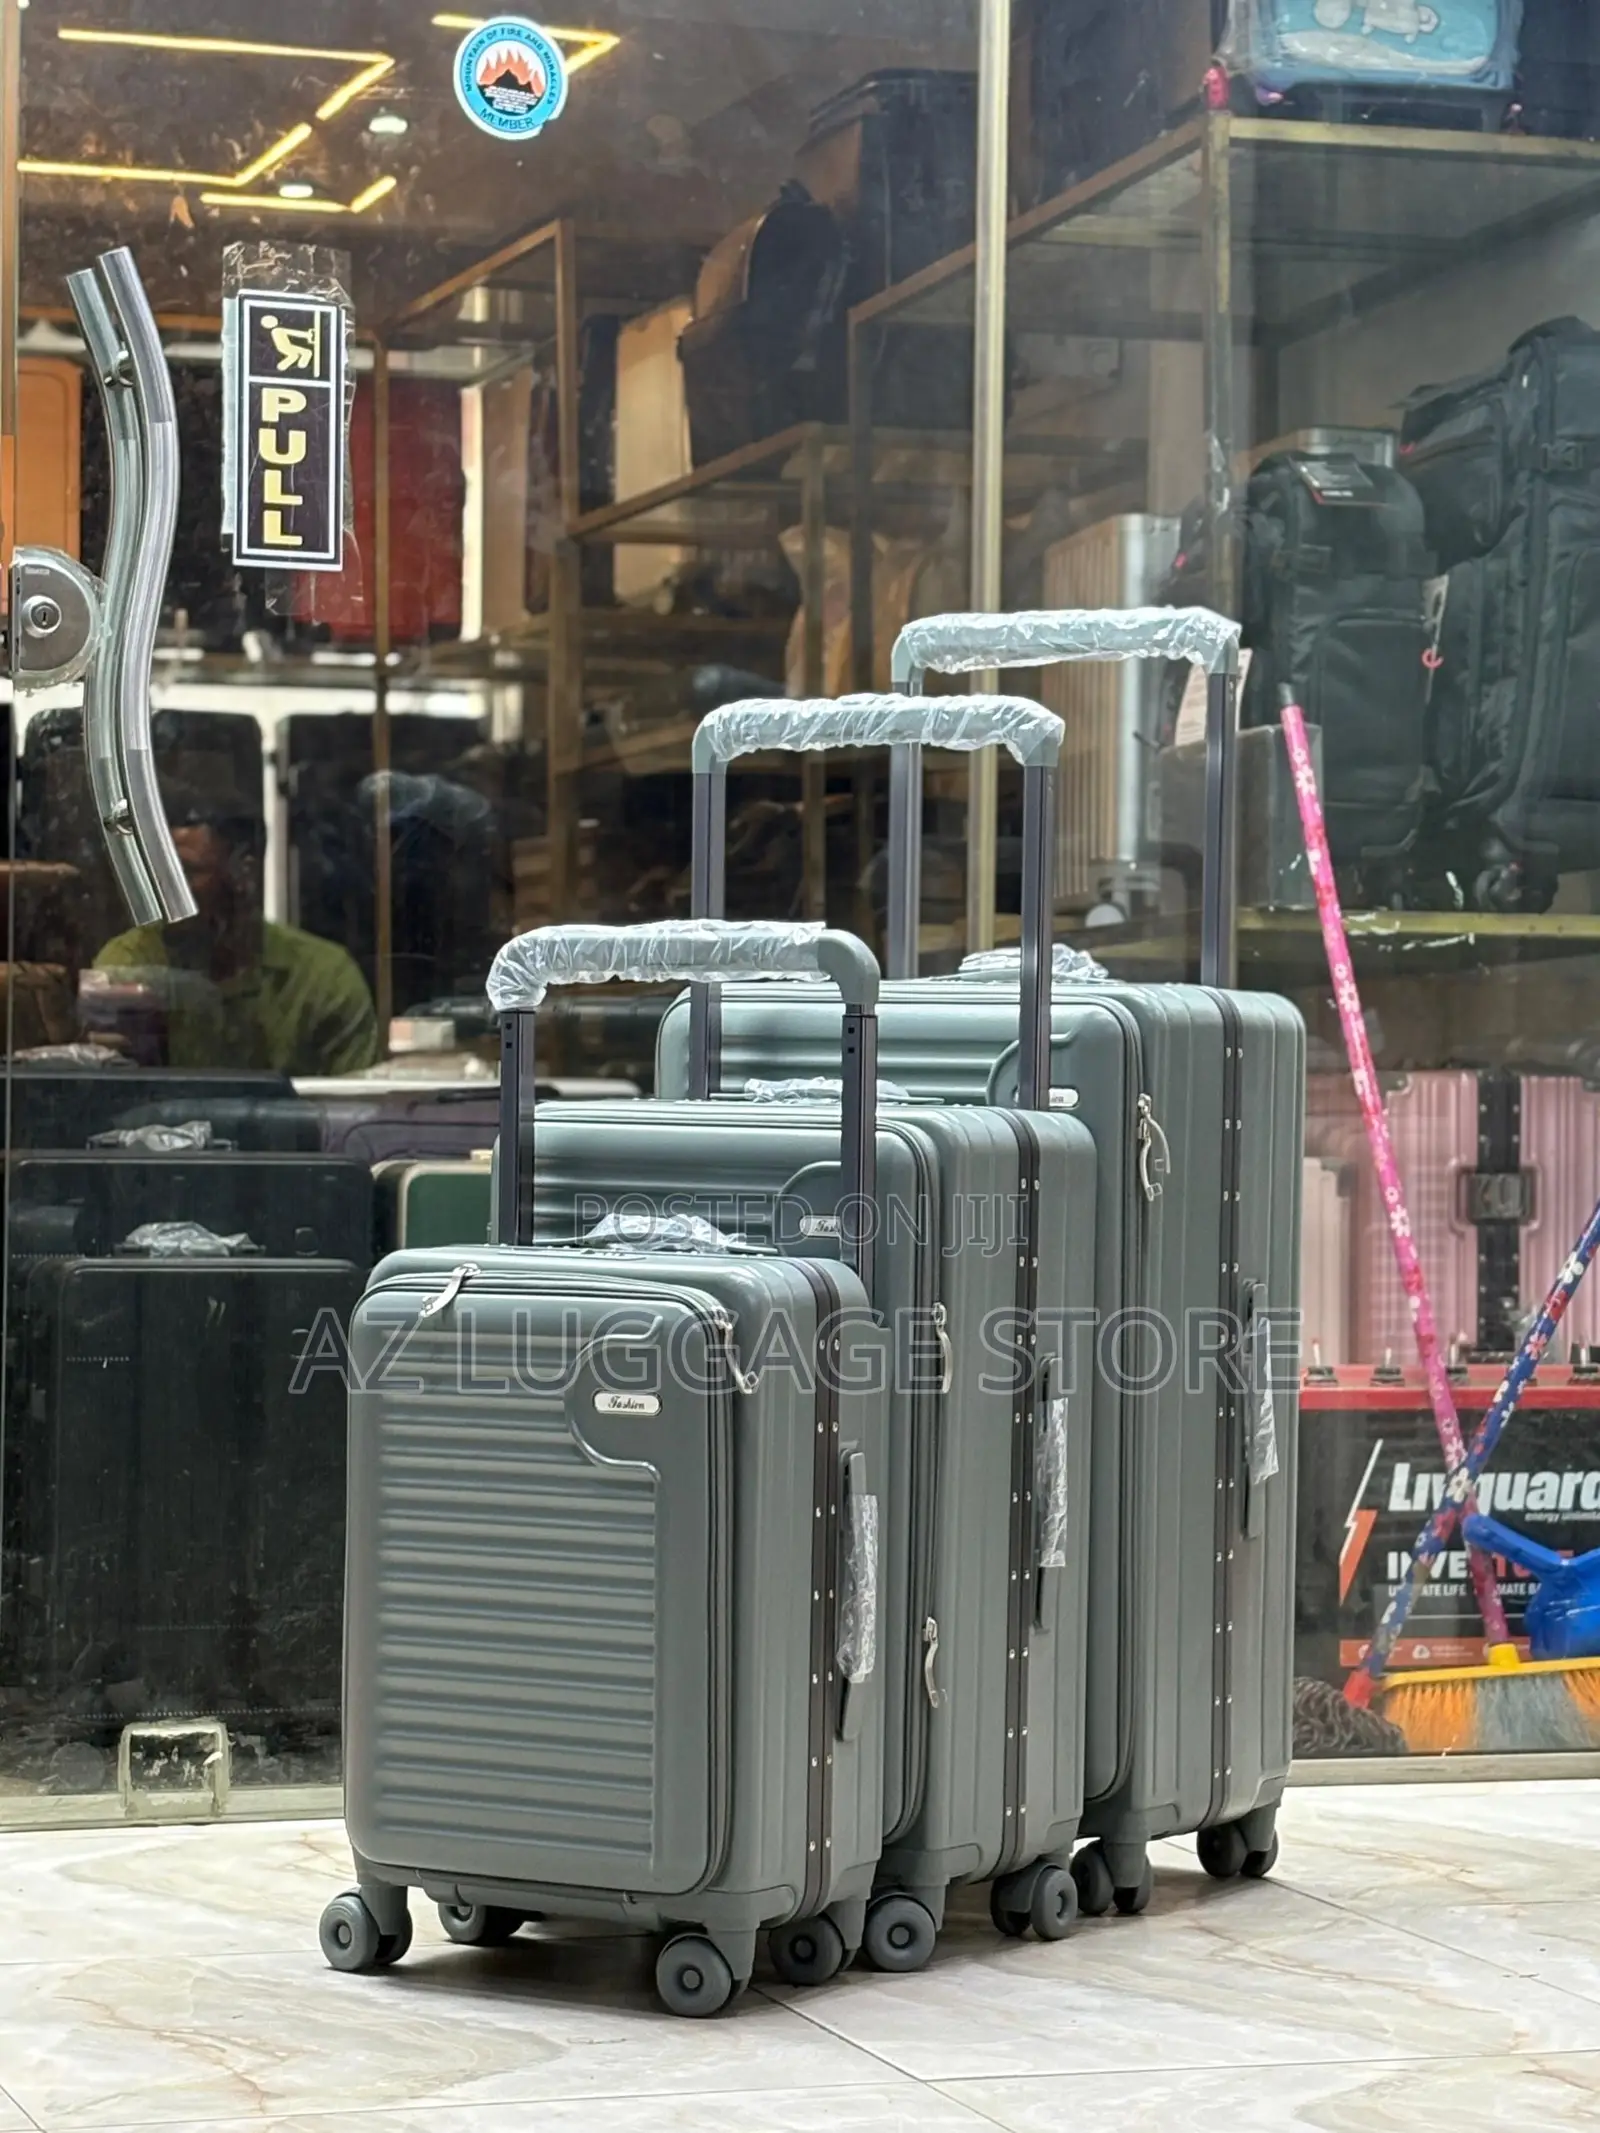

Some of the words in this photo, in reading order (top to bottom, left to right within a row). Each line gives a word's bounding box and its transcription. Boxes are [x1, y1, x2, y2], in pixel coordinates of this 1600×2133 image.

[464, 38, 486, 92] MOUNTAIN
[486, 30, 498, 40] OF
[500, 27, 523, 38] FIRE
[524, 33, 544, 51] AND
[480, 107, 534, 130] MEMBER
[258, 386, 307, 546] PULL
[1443, 1583, 1467, 1597] LIFE
